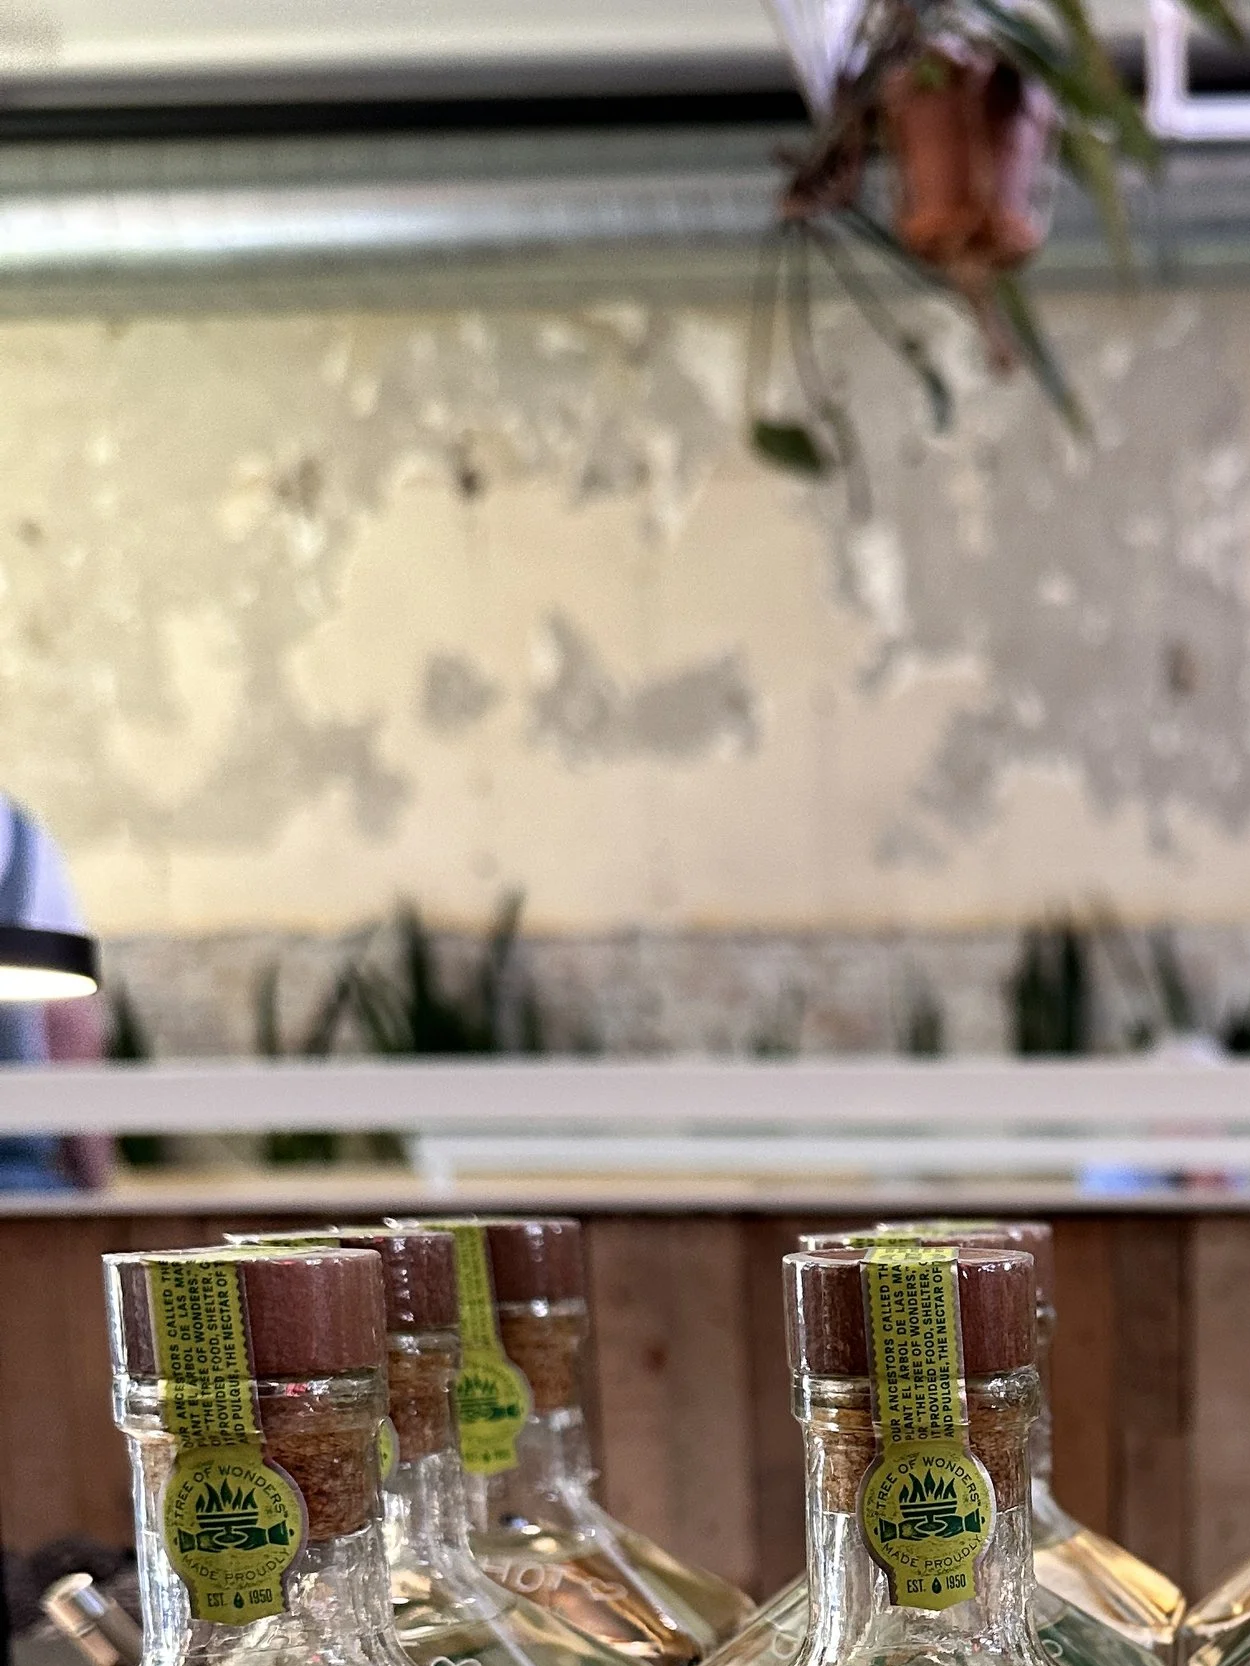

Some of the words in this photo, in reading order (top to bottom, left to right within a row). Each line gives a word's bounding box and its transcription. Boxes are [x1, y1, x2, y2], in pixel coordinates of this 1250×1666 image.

[932, 1267, 943, 1283] OF
[163, 1289, 178, 1337] CALLED
[880, 1285, 893, 1332] CALLED
[893, 1290, 905, 1313] LAS
[919, 1269, 933, 1325] SHELTER,
[934, 1286, 947, 1334] NECTAR
[895, 1319, 907, 1335] DE
[911, 1341, 922, 1356] OF
[924, 1328, 936, 1364] FOOD,
[937, 1337, 949, 1360] THE
[169, 1344, 188, 1419] ANCESTORS
[884, 1338, 900, 1412] ANCESTORS
[912, 1361, 925, 1390] TREE
[940, 1361, 952, 1412] PULQUE,
[902, 1386, 912, 1399] EL
[927, 1368, 941, 1428] PROVIDED
[891, 1418, 902, 1441] OUR
[903, 1405, 915, 1440] PLANT
[917, 1426, 928, 1439] OR
[931, 1430, 941, 1439] IT
[943, 1414, 954, 1438] AND
[174, 1481, 194, 1519] TREE
[193, 1466, 212, 1483] OF
[876, 1472, 898, 1510] TREE
[898, 1457, 917, 1475] OF
[181, 1553, 219, 1581] MADE
[224, 1547, 290, 1581] PROUDLY
[881, 1543, 920, 1568] MADE
[924, 1534, 985, 1570] PROUDLY
[207, 1592, 228, 1608] EST.
[248, 1588, 273, 1605] 1950
[906, 1579, 927, 1593] EST.
[945, 1573, 966, 1589] 1950
